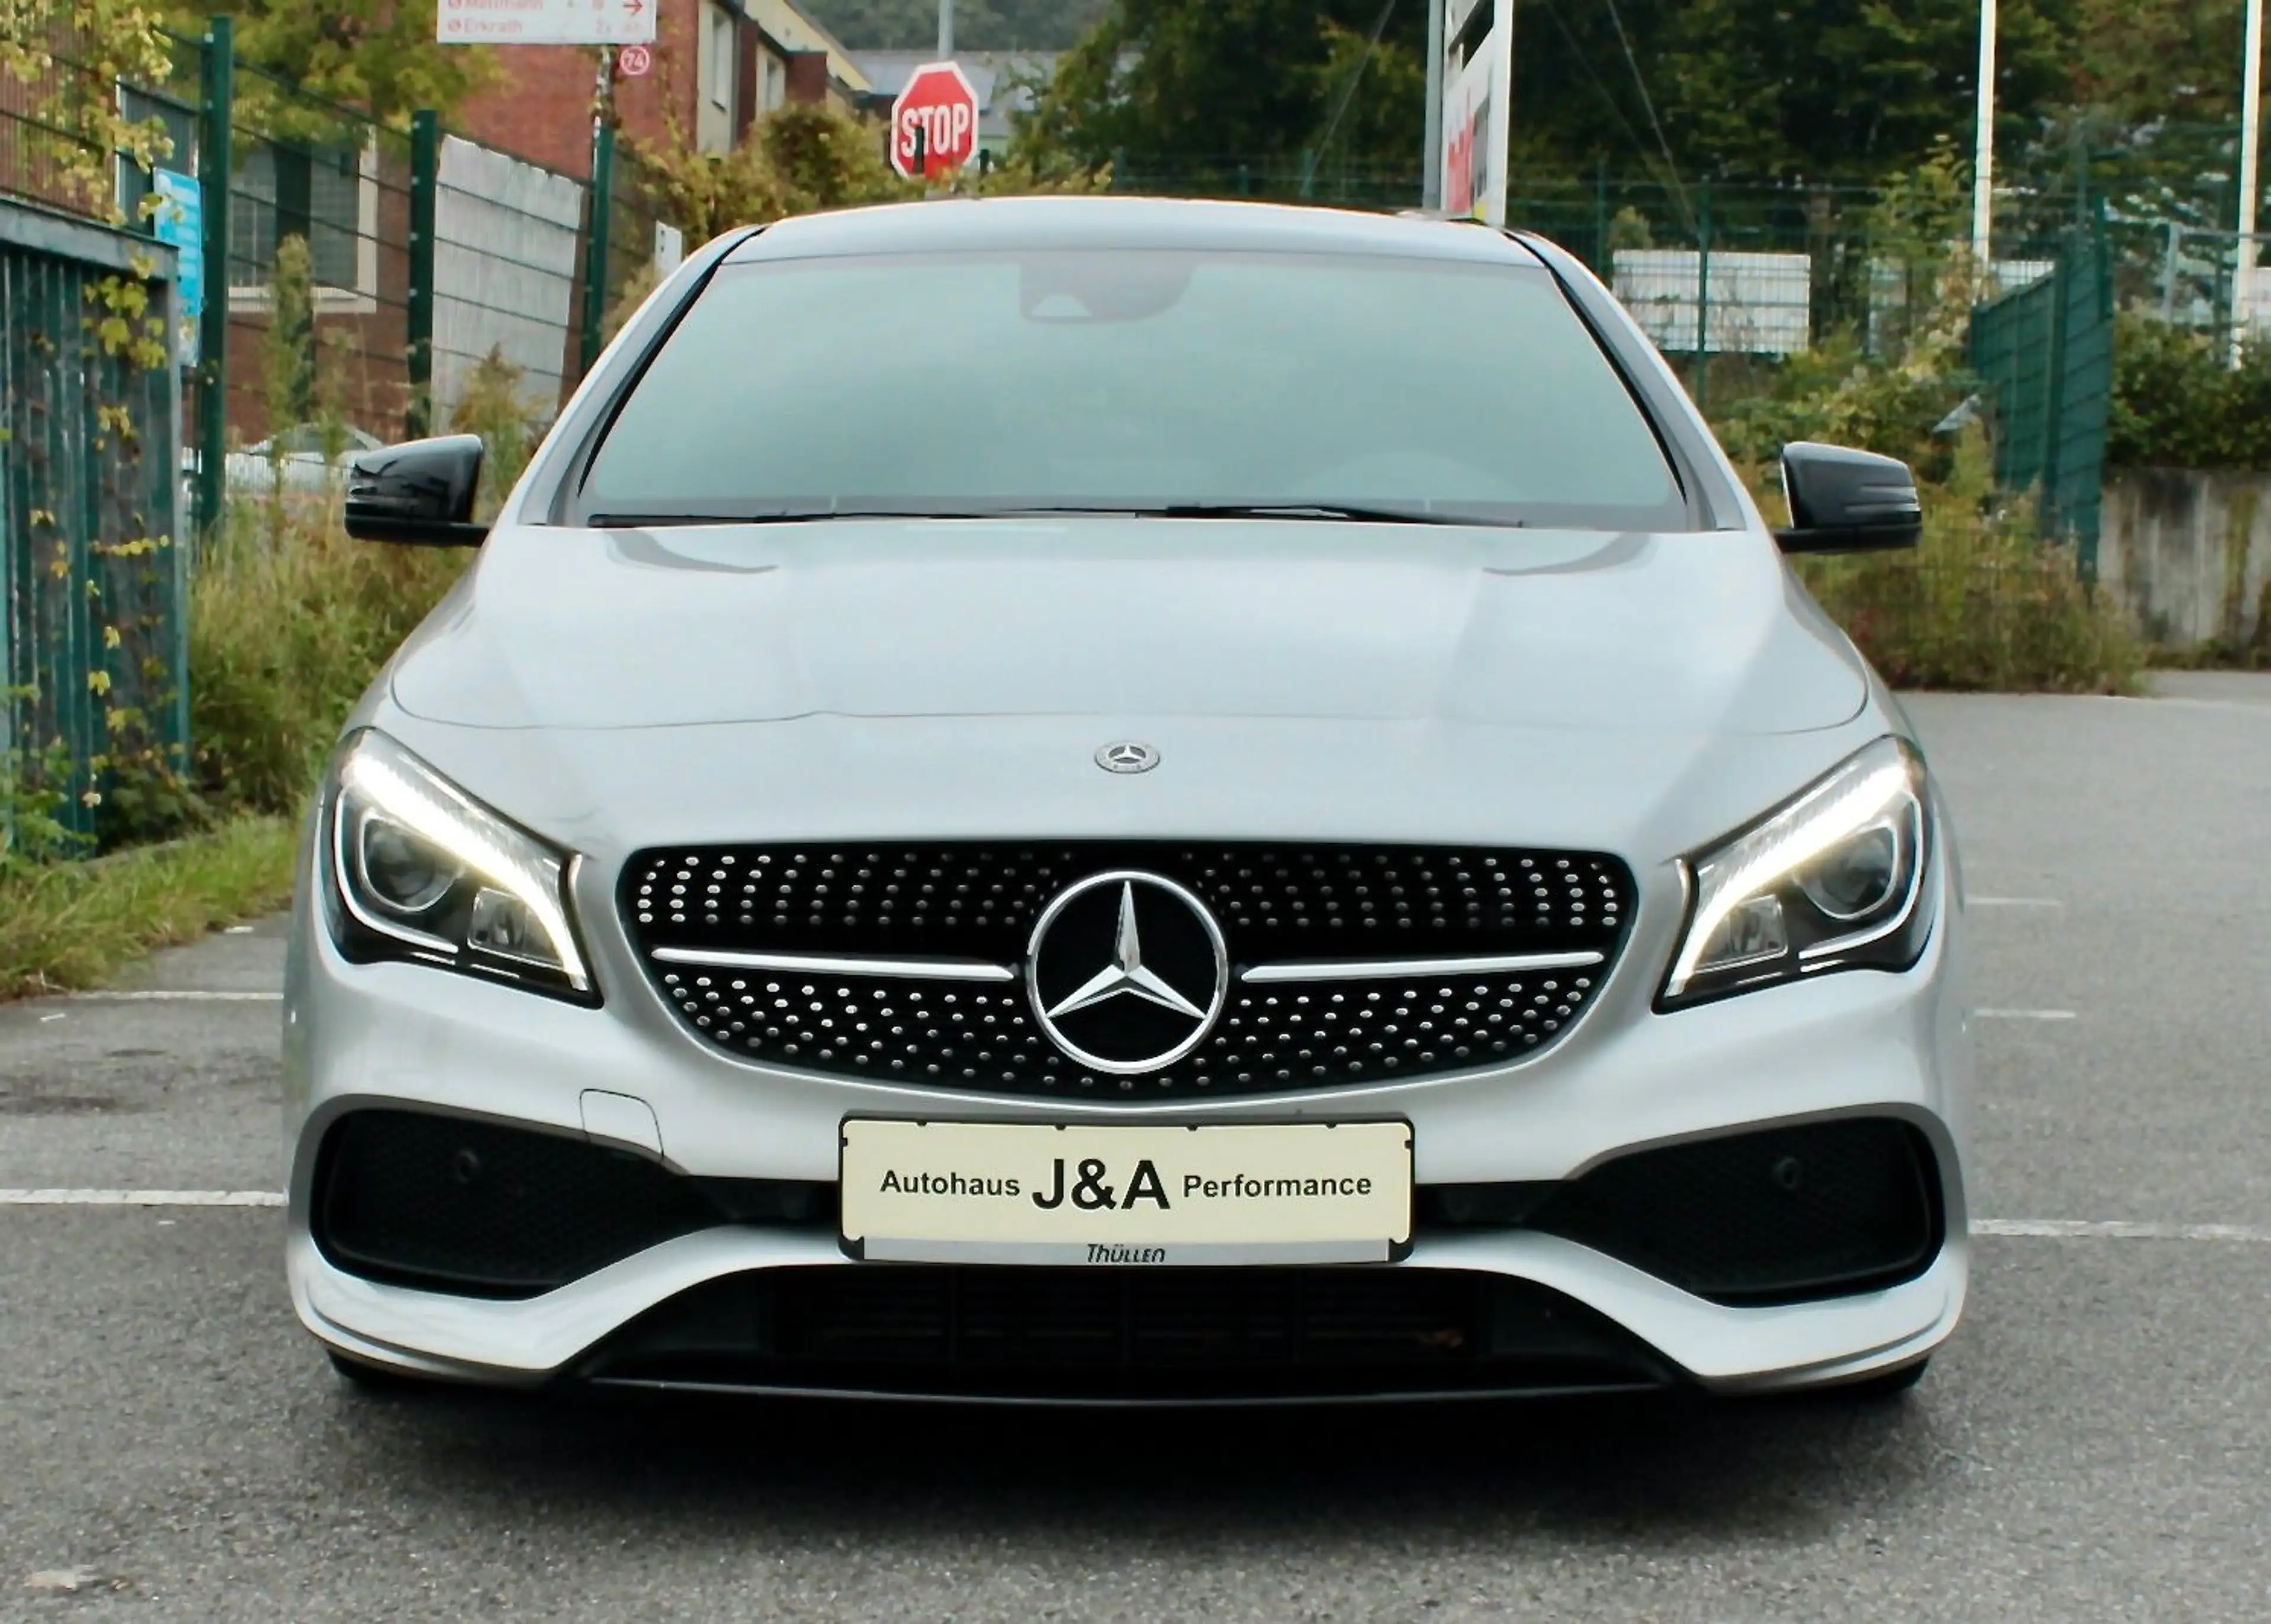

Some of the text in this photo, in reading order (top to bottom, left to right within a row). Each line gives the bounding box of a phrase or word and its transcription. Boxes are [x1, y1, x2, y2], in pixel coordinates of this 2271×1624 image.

[901, 103, 969, 157] STOP
[880, 1158, 1371, 1210] Autohaus J&A Performance
